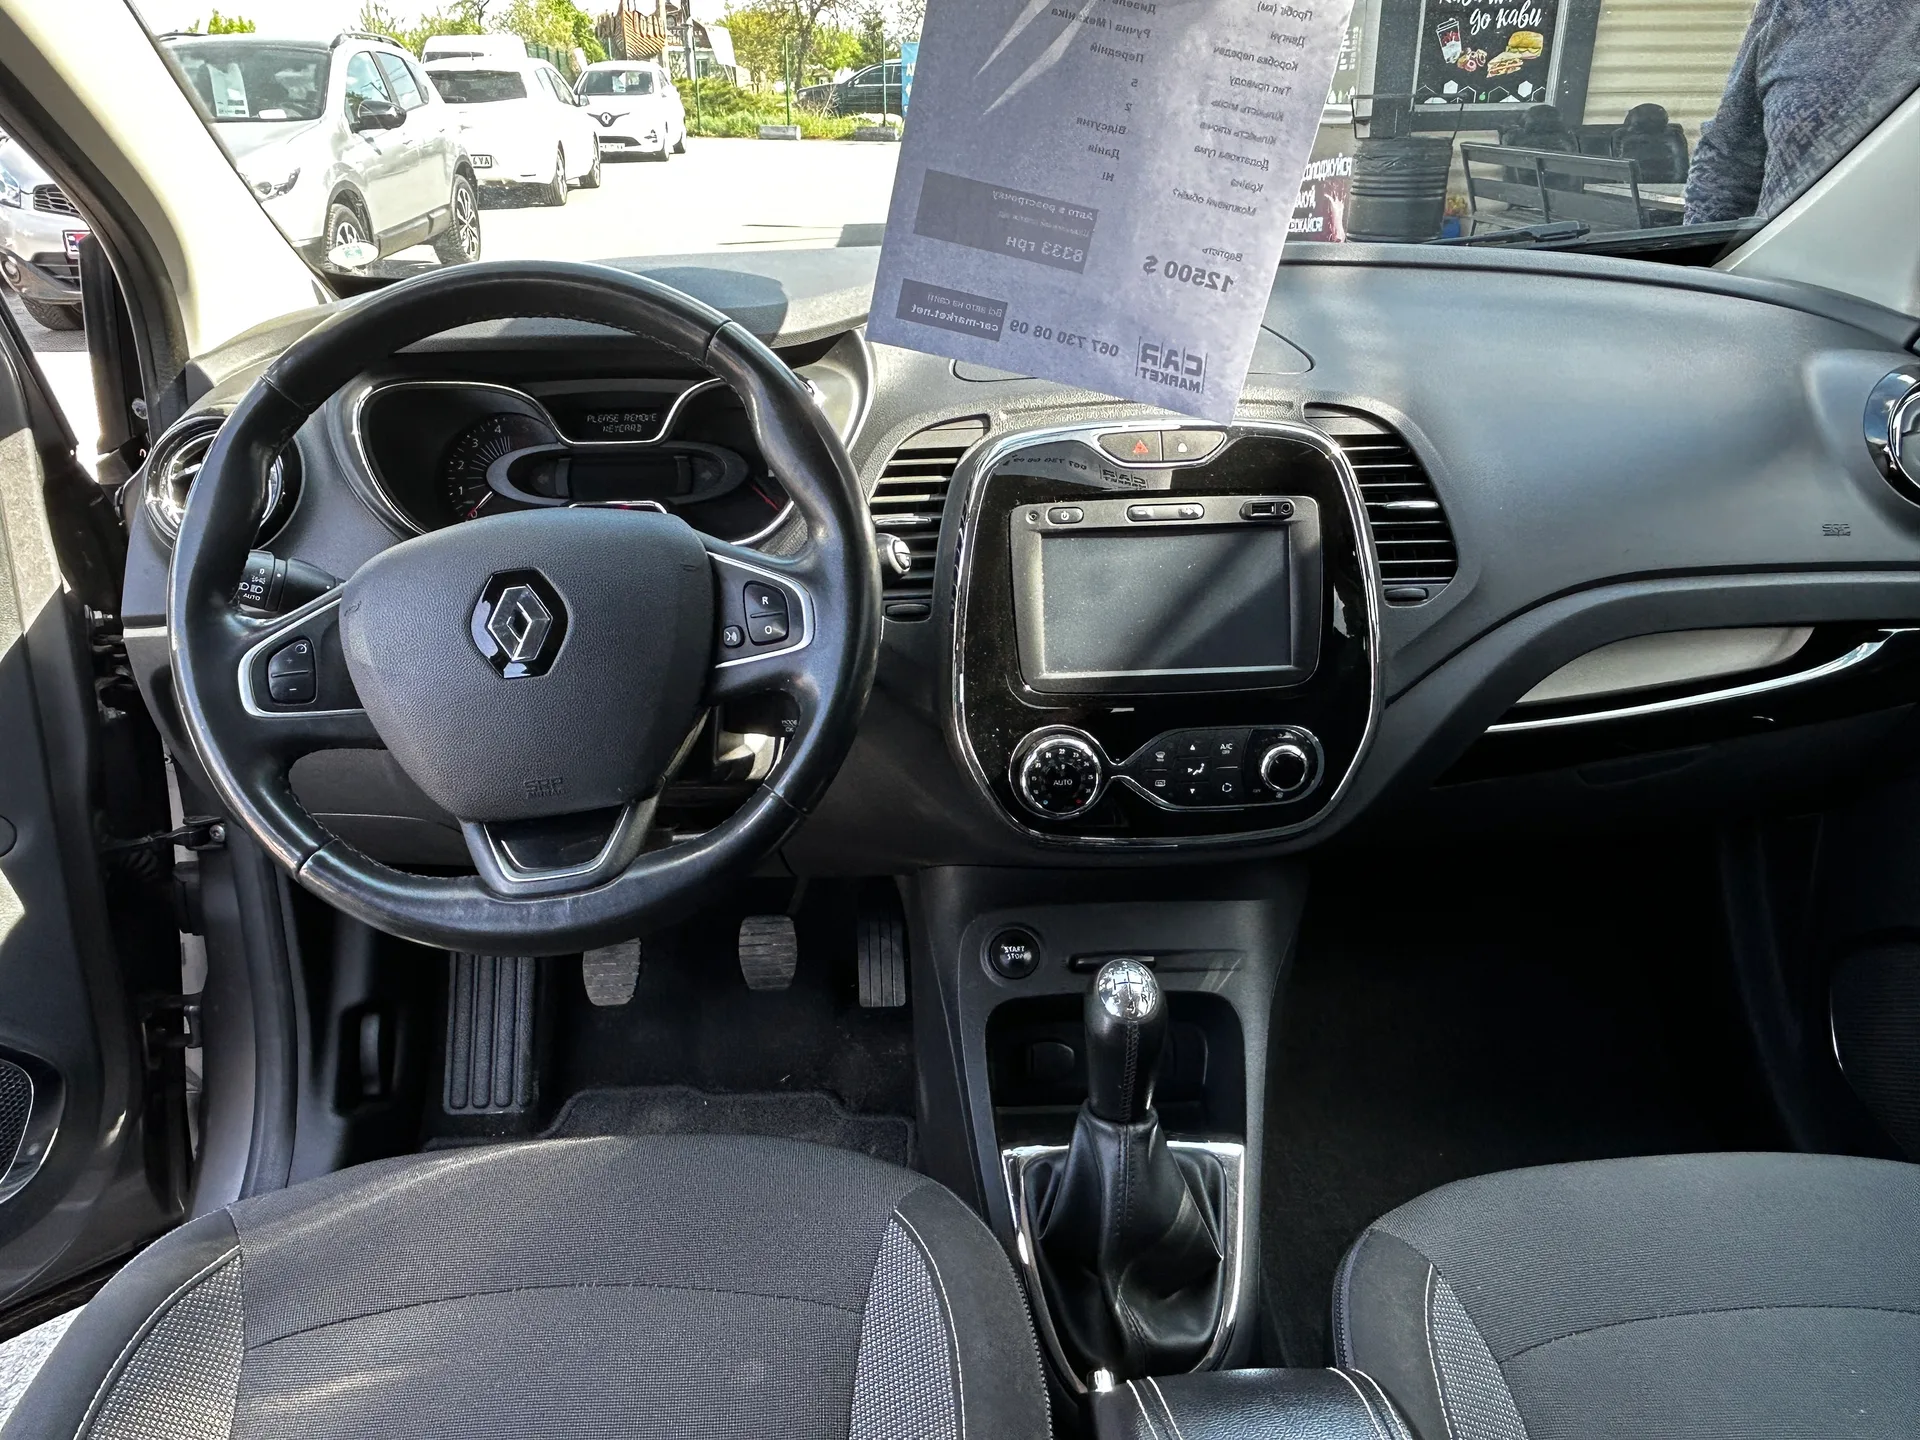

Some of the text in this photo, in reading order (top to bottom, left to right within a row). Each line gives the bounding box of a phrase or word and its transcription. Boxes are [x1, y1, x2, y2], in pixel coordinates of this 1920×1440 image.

[586, 413, 657, 423] PLEASE REMOVE
[494, 425, 502, 434] 4
[472, 439, 479, 448] 3
[457, 460, 465, 470] 2
[458, 486, 463, 495] 1
[242, 593, 261, 601] AUTO
[762, 596, 769, 605] R
